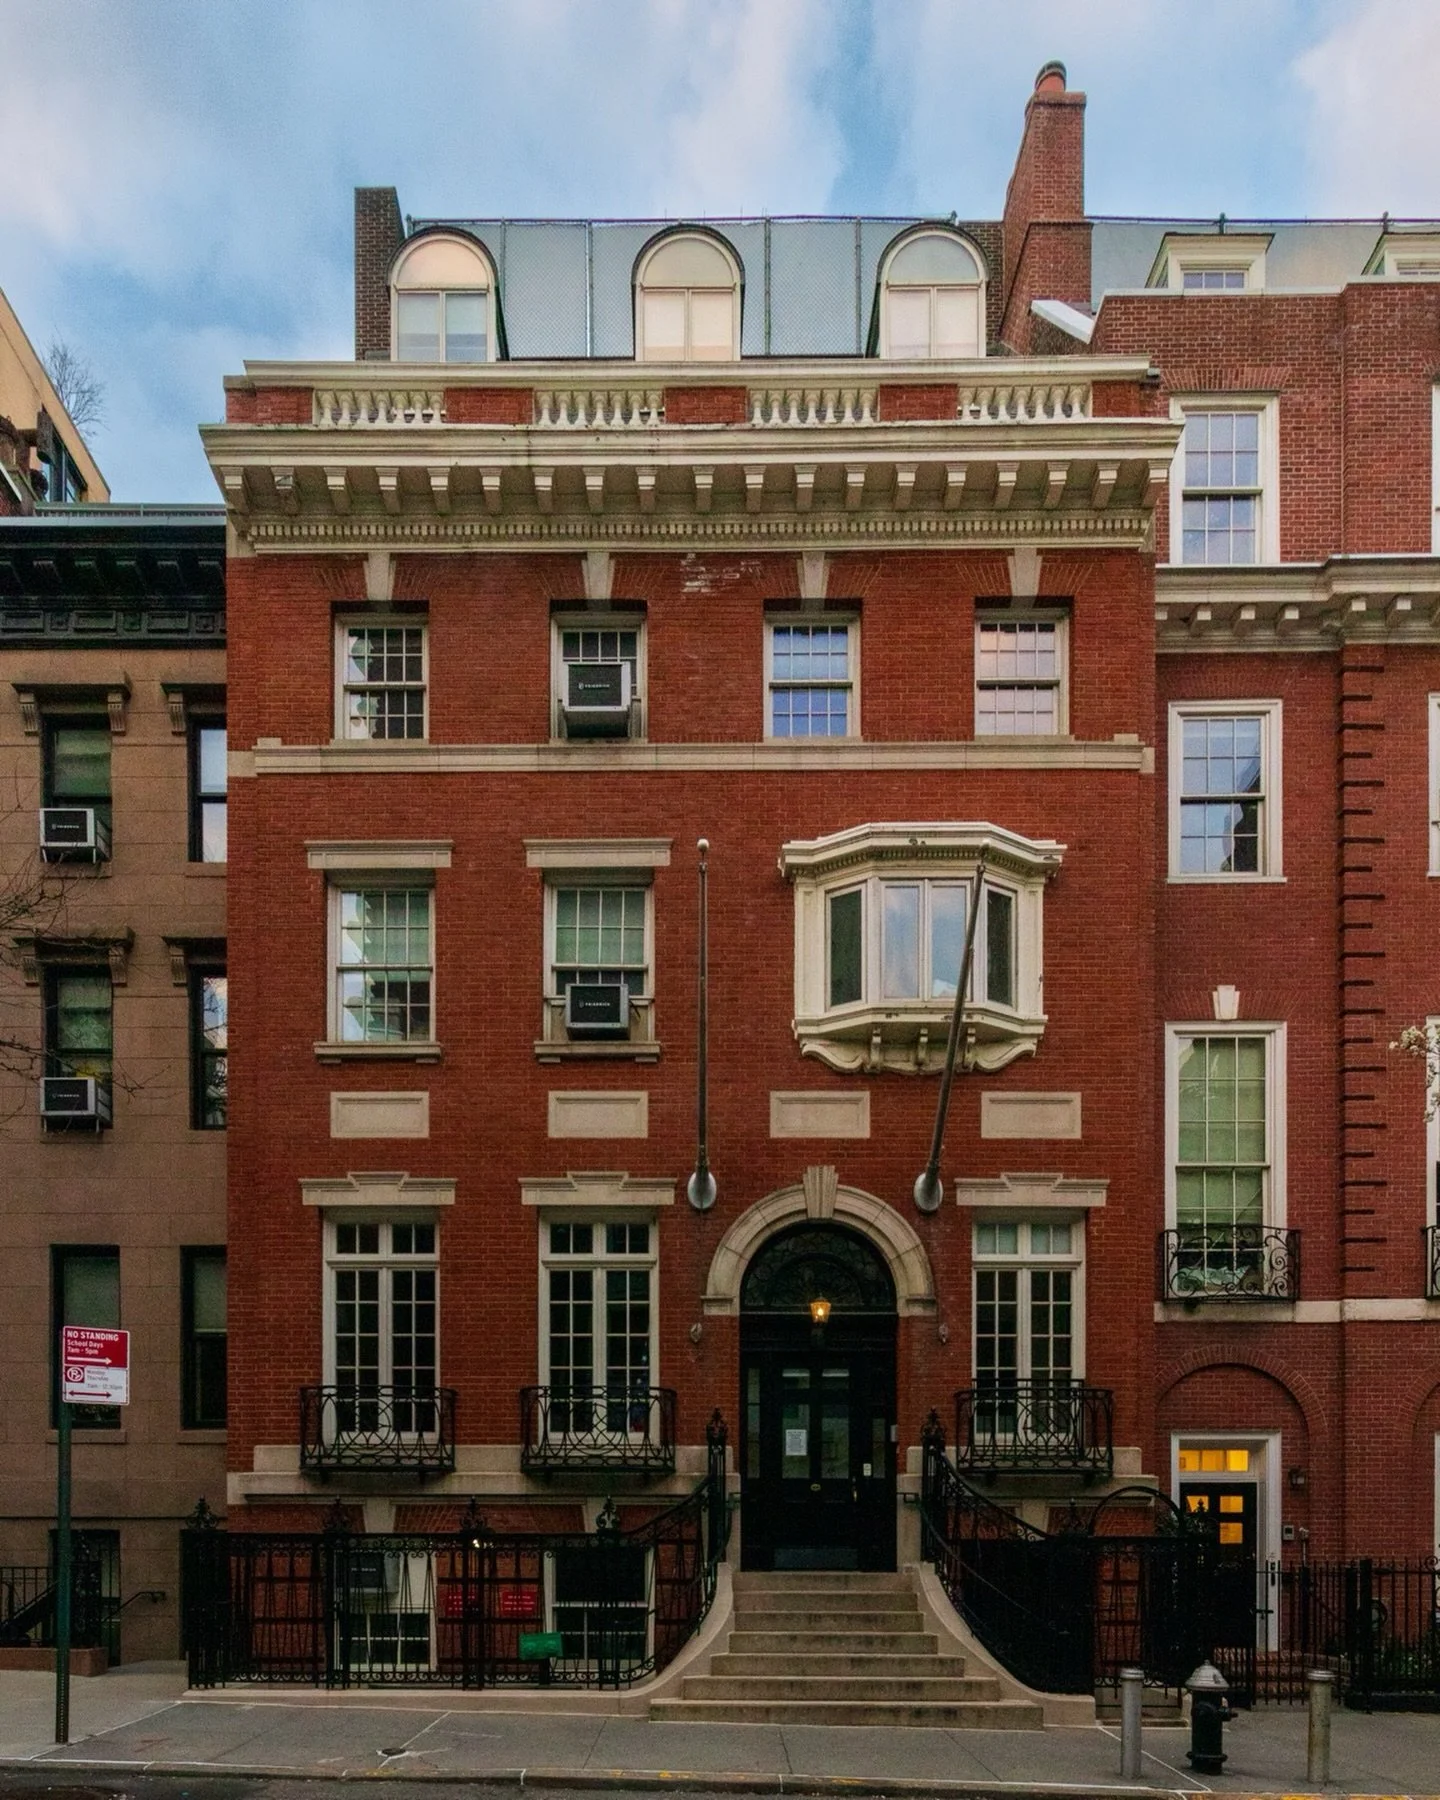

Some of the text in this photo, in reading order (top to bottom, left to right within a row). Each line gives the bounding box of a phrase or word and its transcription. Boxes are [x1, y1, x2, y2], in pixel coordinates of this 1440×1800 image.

[67, 1330, 119, 1342] NO STANDING
[67, 1339, 104, 1349] School Days
